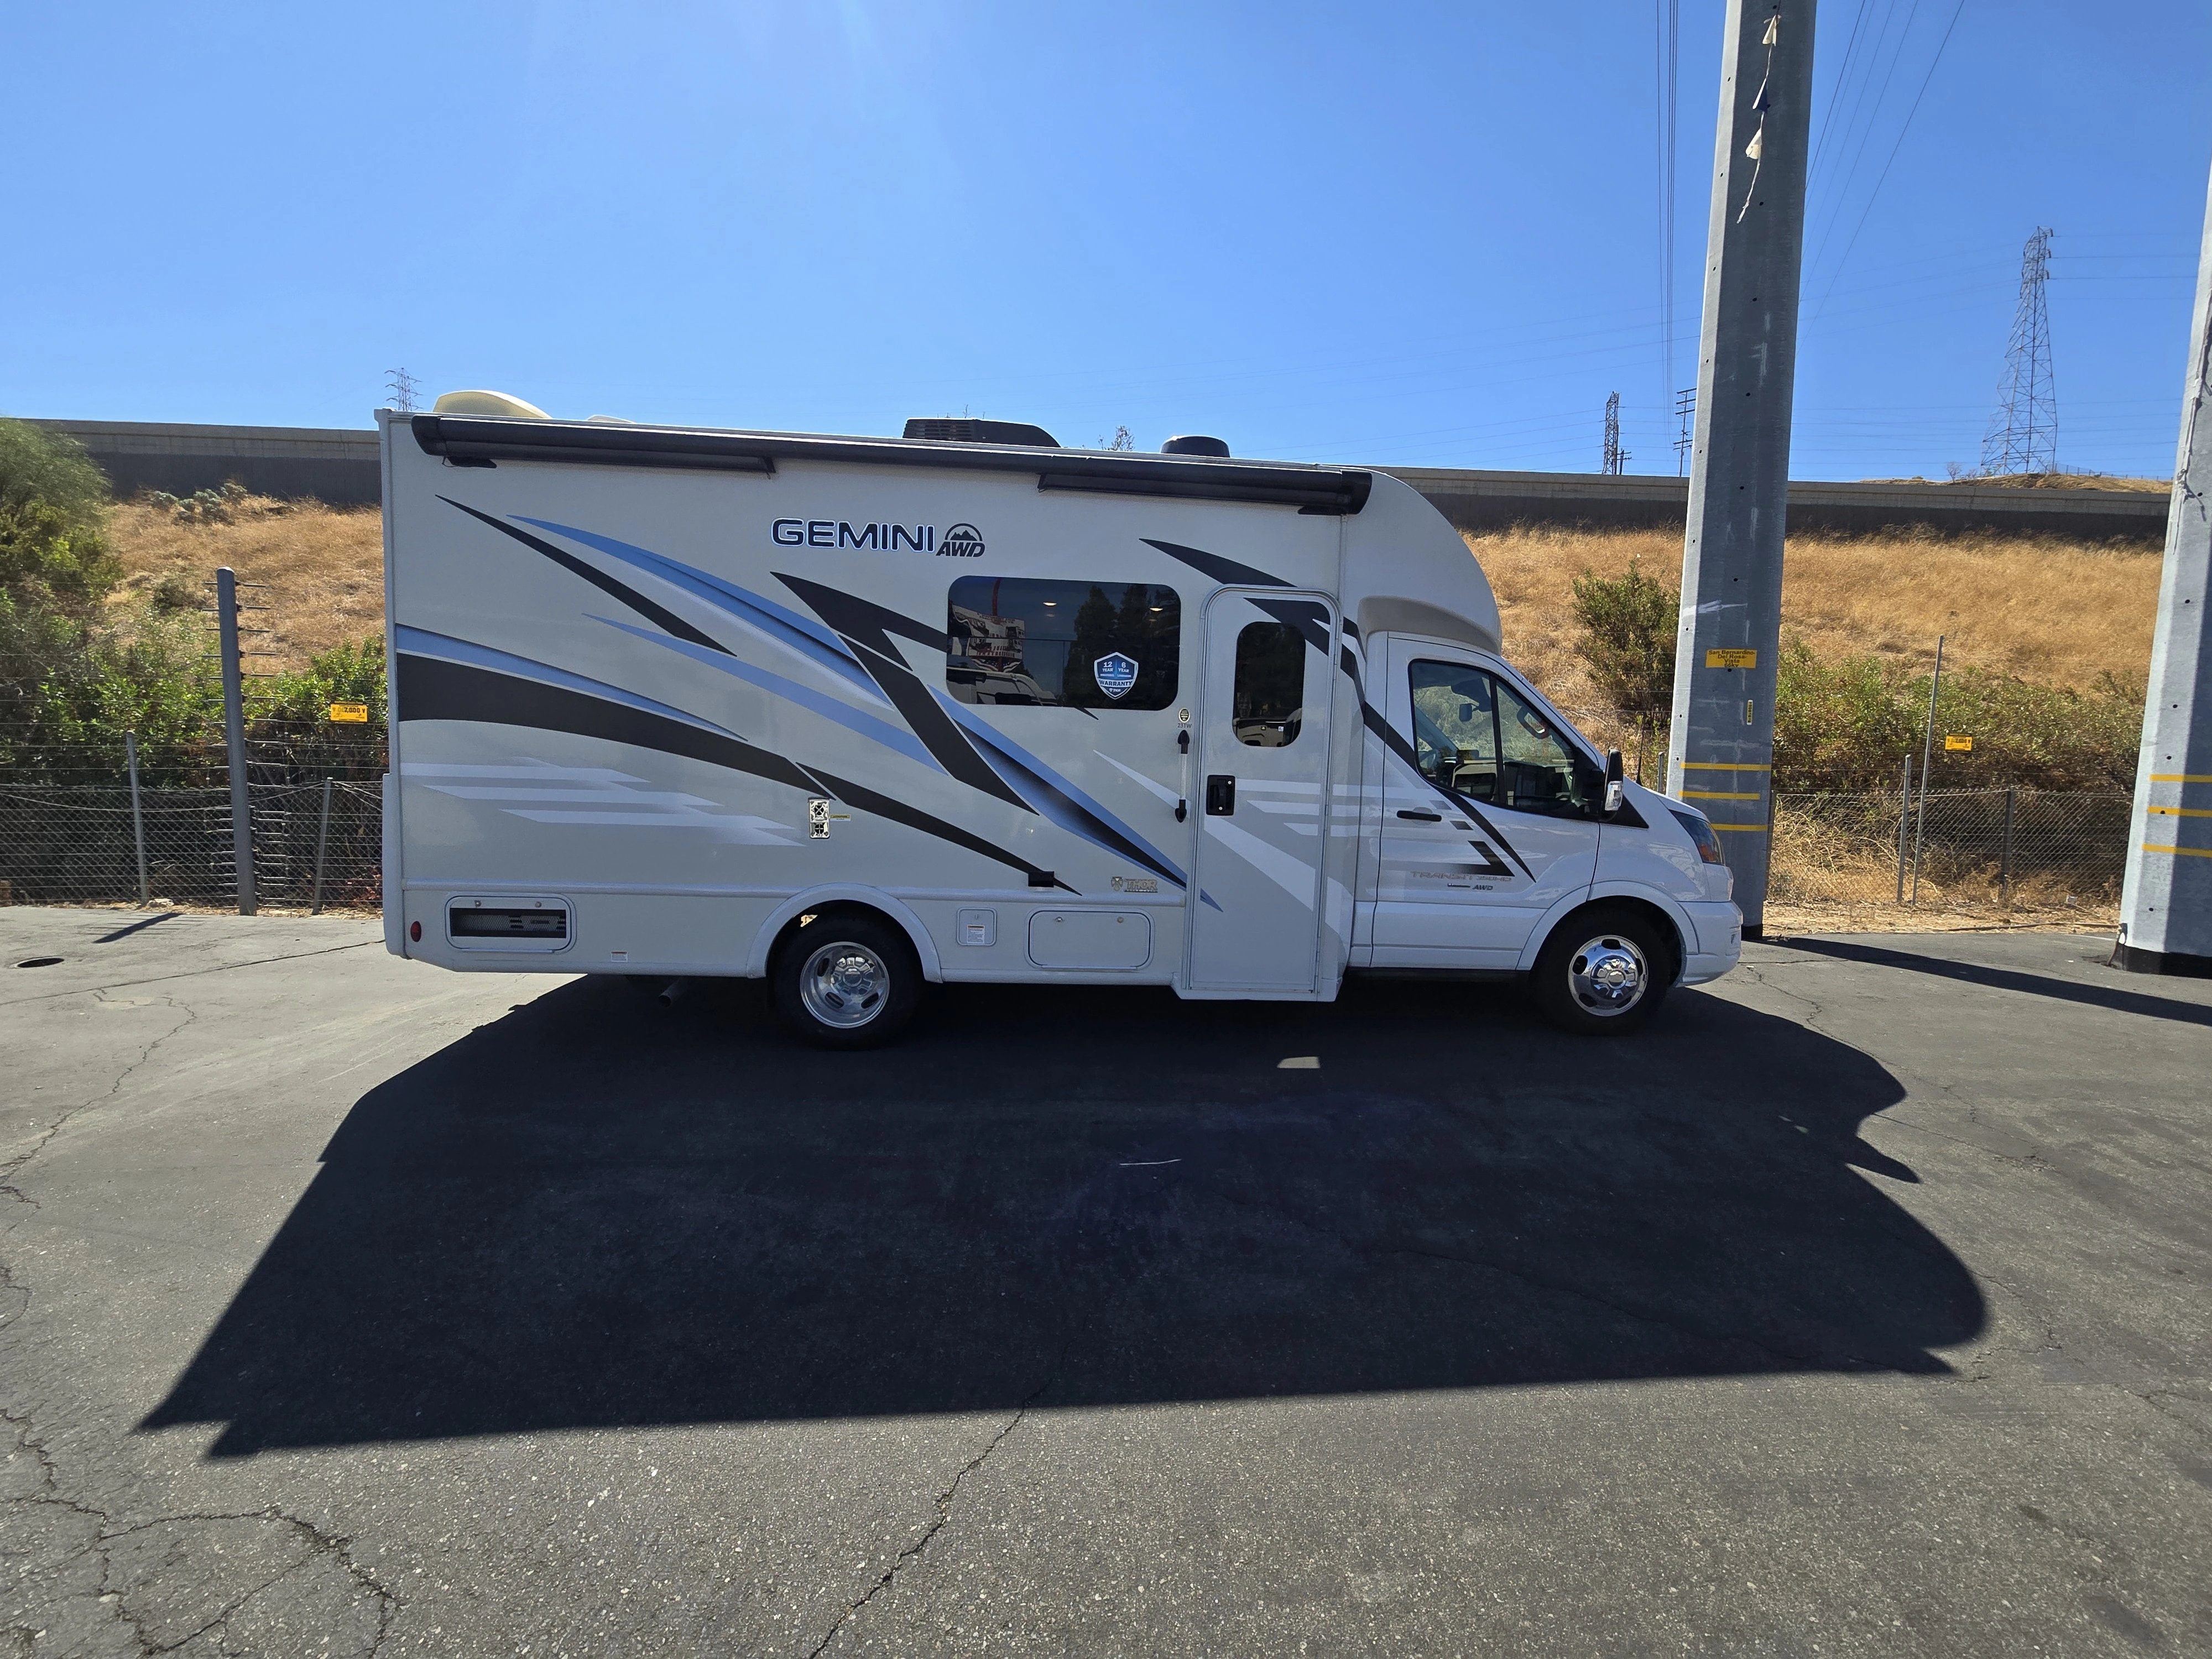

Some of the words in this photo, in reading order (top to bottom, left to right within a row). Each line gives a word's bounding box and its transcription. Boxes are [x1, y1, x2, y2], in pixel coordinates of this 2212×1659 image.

[771, 518, 935, 552] GEMINI
[936, 541, 985, 557] AWD
[1124, 878, 1158, 890] THOR
